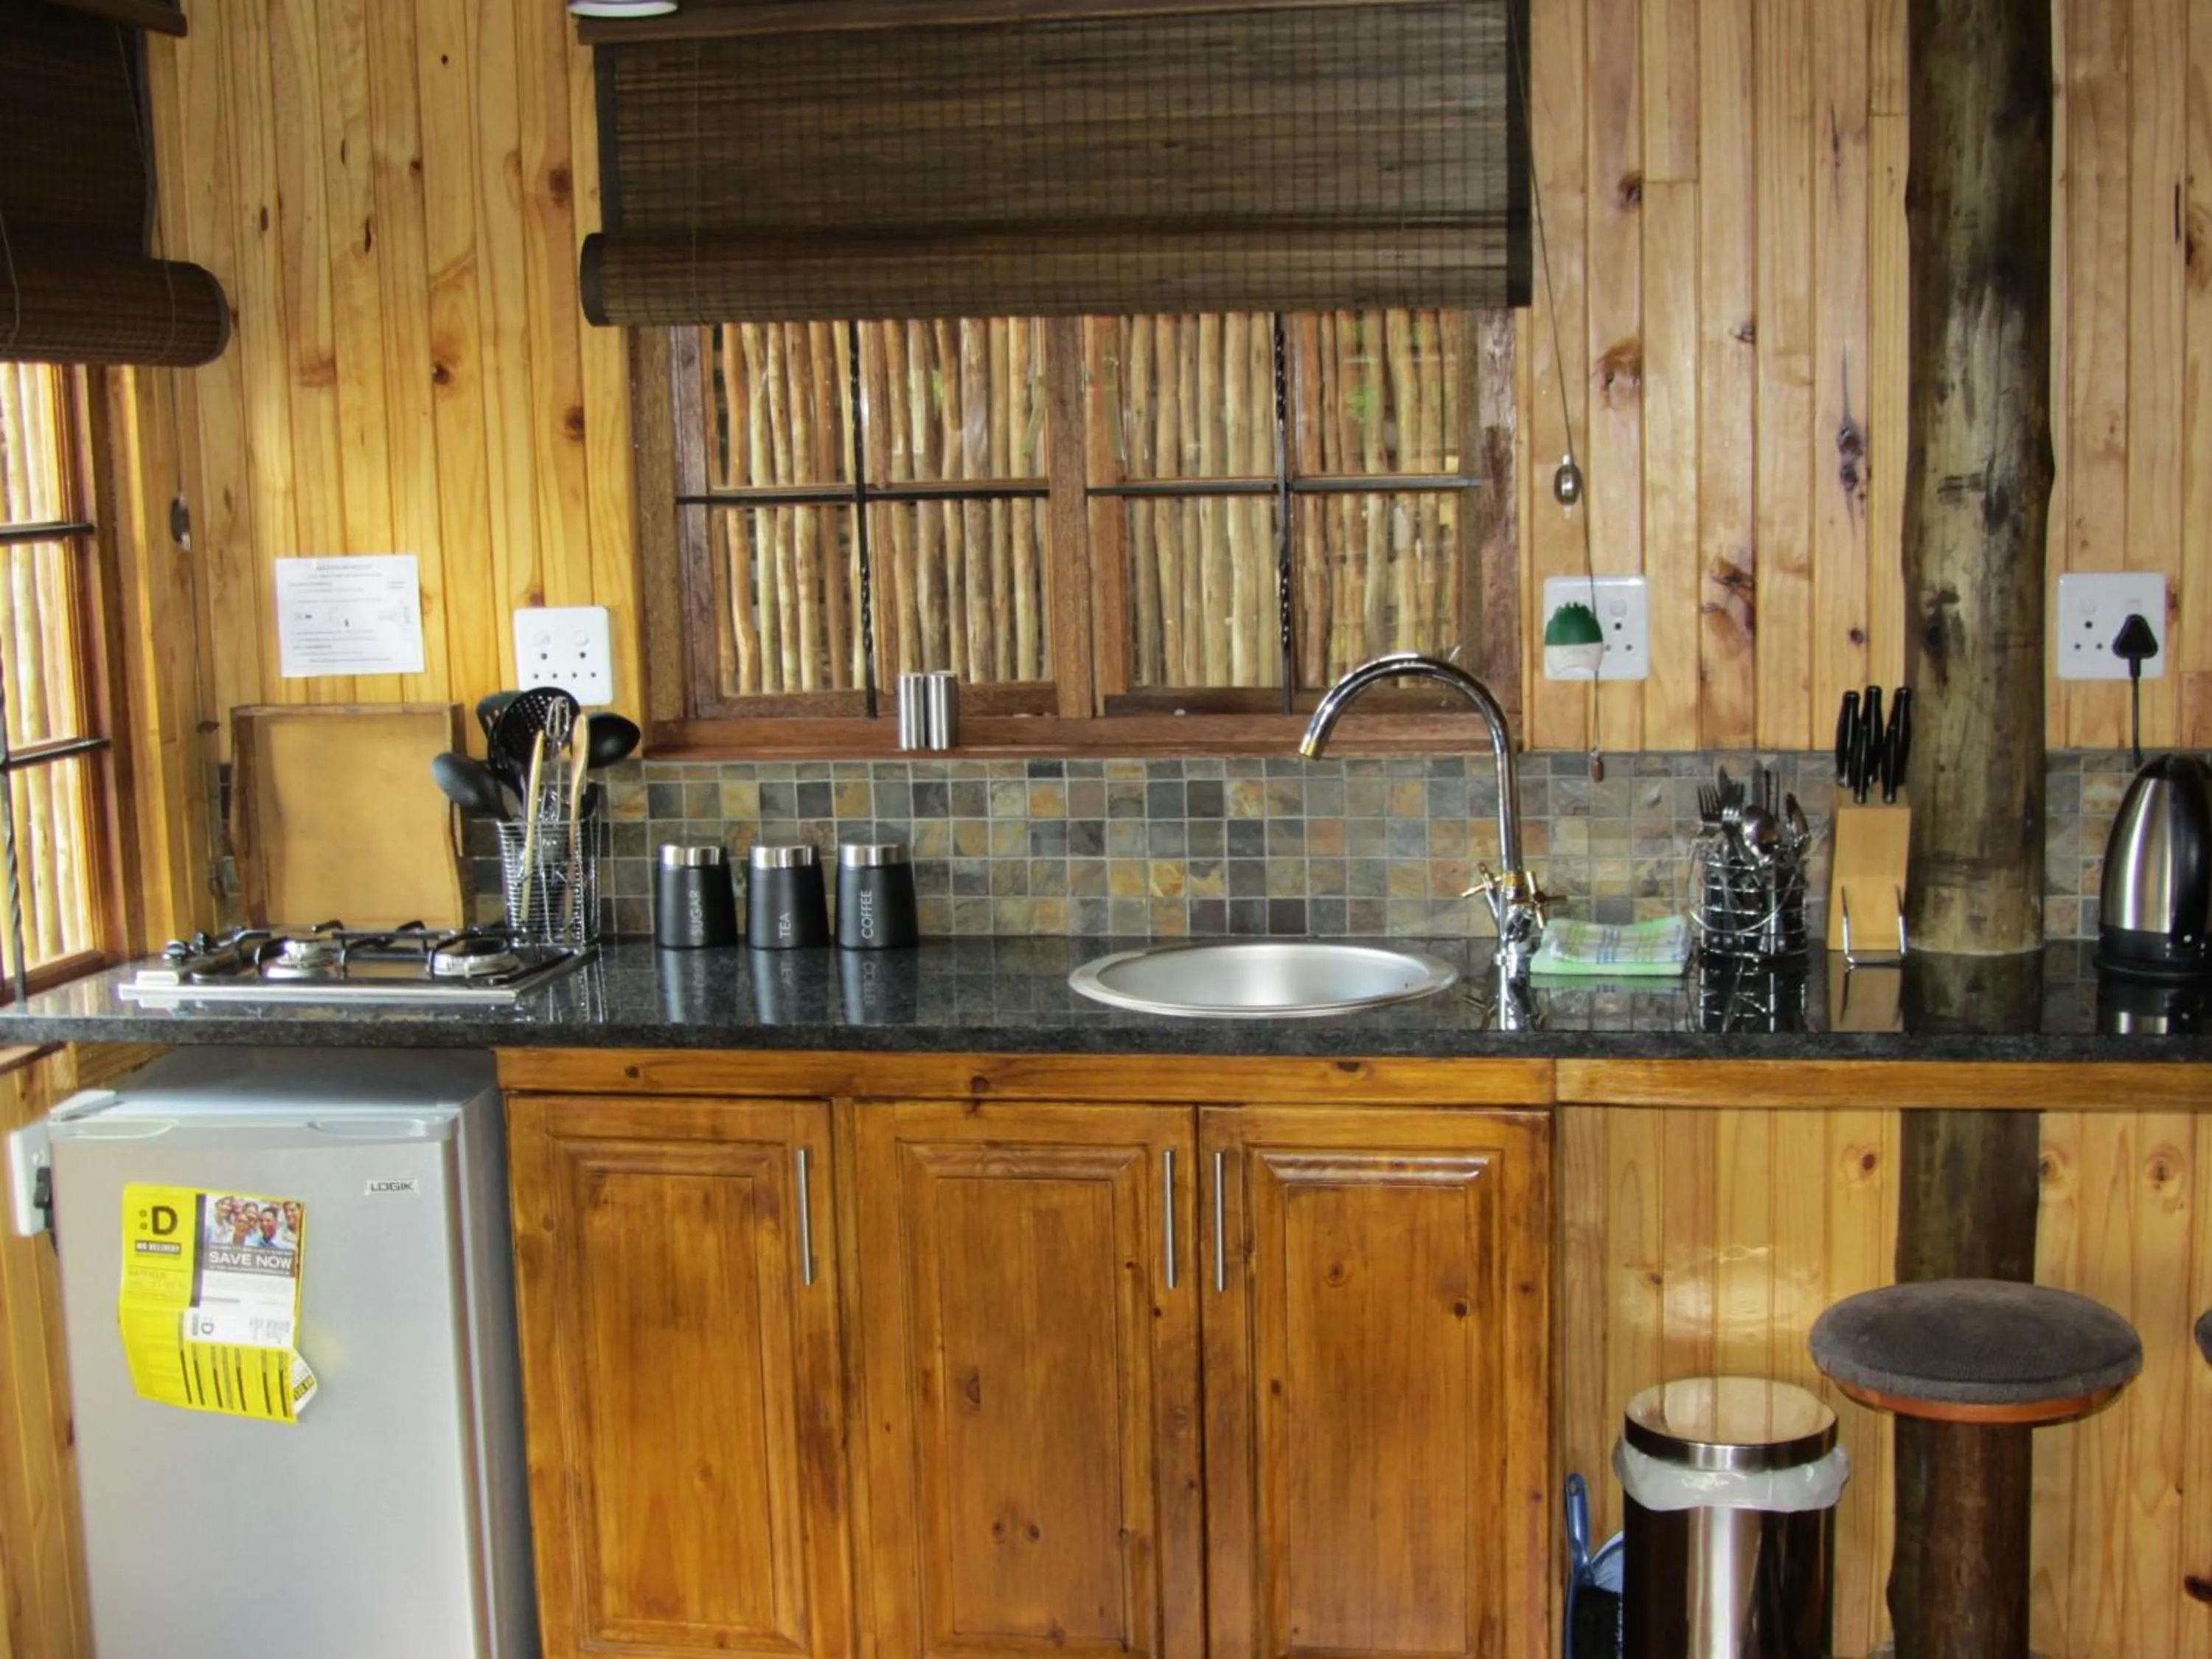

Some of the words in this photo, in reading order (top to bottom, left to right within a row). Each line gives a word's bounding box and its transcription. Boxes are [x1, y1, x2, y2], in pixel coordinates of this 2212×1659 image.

[689, 889, 703, 937] SUGAR
[779, 911, 791, 939] TEA
[860, 889, 874, 939] COFFEE
[371, 1182, 414, 1192] LOGIK
[209, 1251, 251, 1266] SAVE
[255, 1254, 292, 1269] NOW
